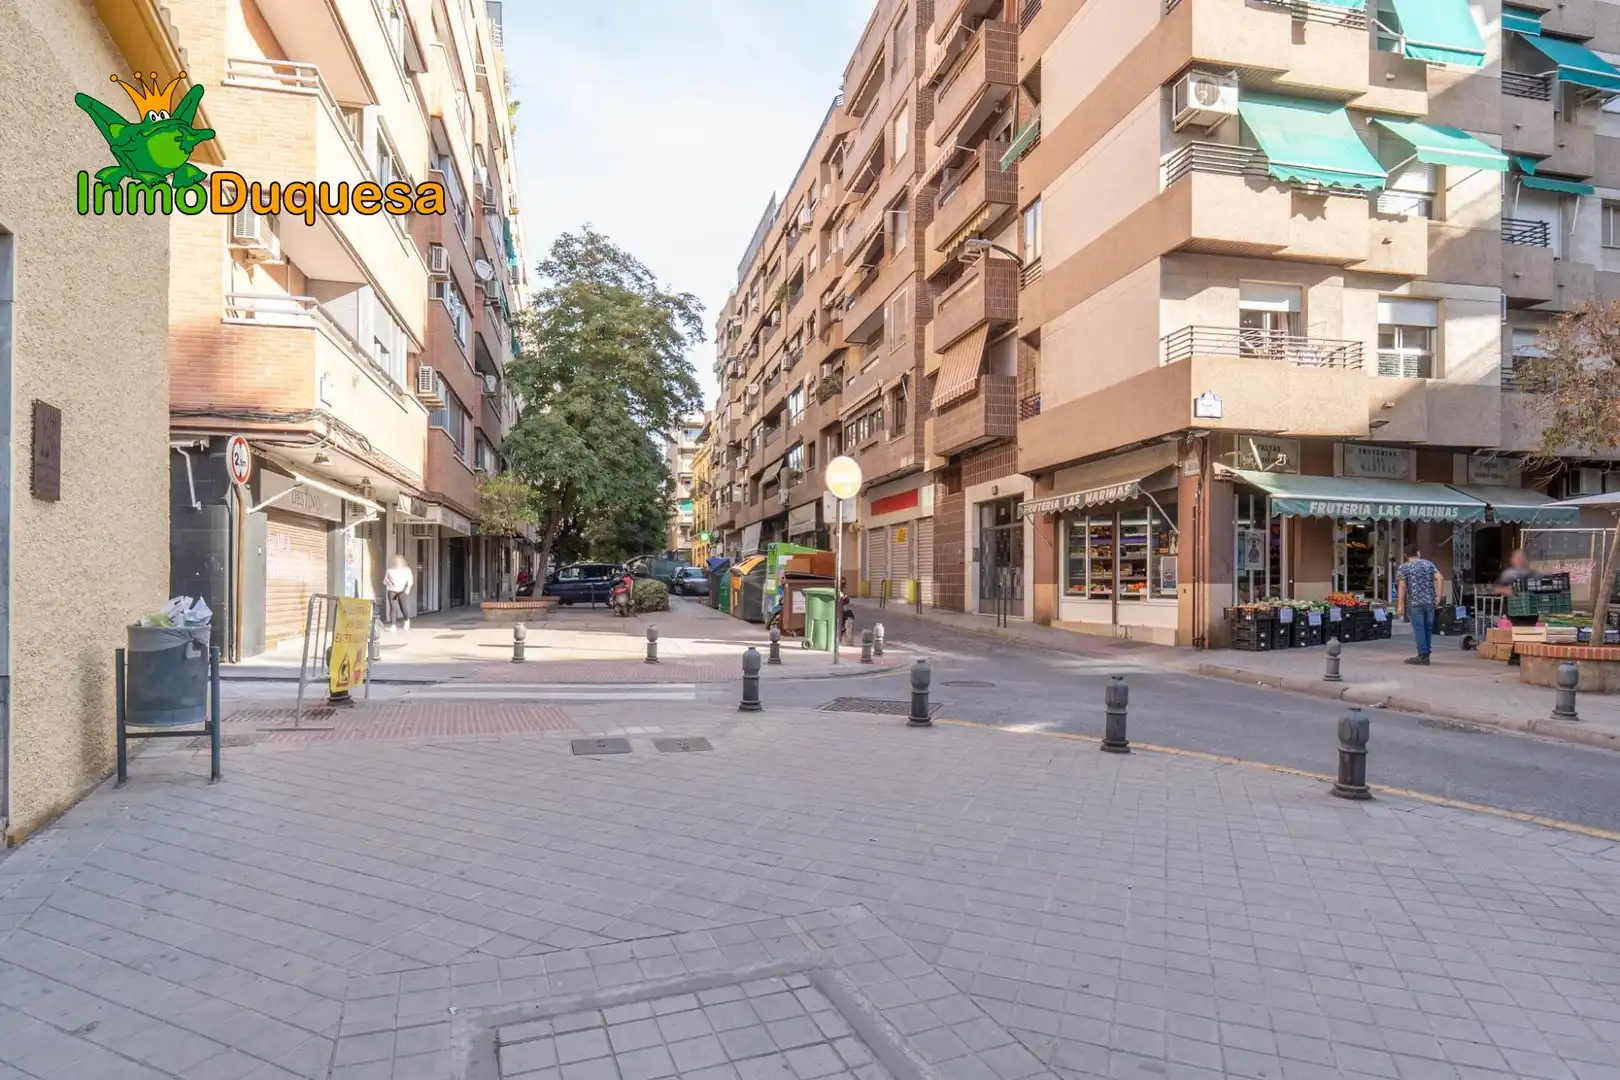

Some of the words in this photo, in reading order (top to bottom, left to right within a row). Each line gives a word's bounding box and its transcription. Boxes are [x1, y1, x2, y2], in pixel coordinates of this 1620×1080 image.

[291, 488, 321, 511] DESTINO
[1024, 499, 1060, 513] FRUTERIA
[1063, 494, 1080, 507] LAS
[1085, 484, 1131, 503] MARINAS
[1309, 501, 1371, 516] FRUTERIA
[1378, 503, 1401, 516] LAS
[1409, 505, 1460, 518] MARINAS
